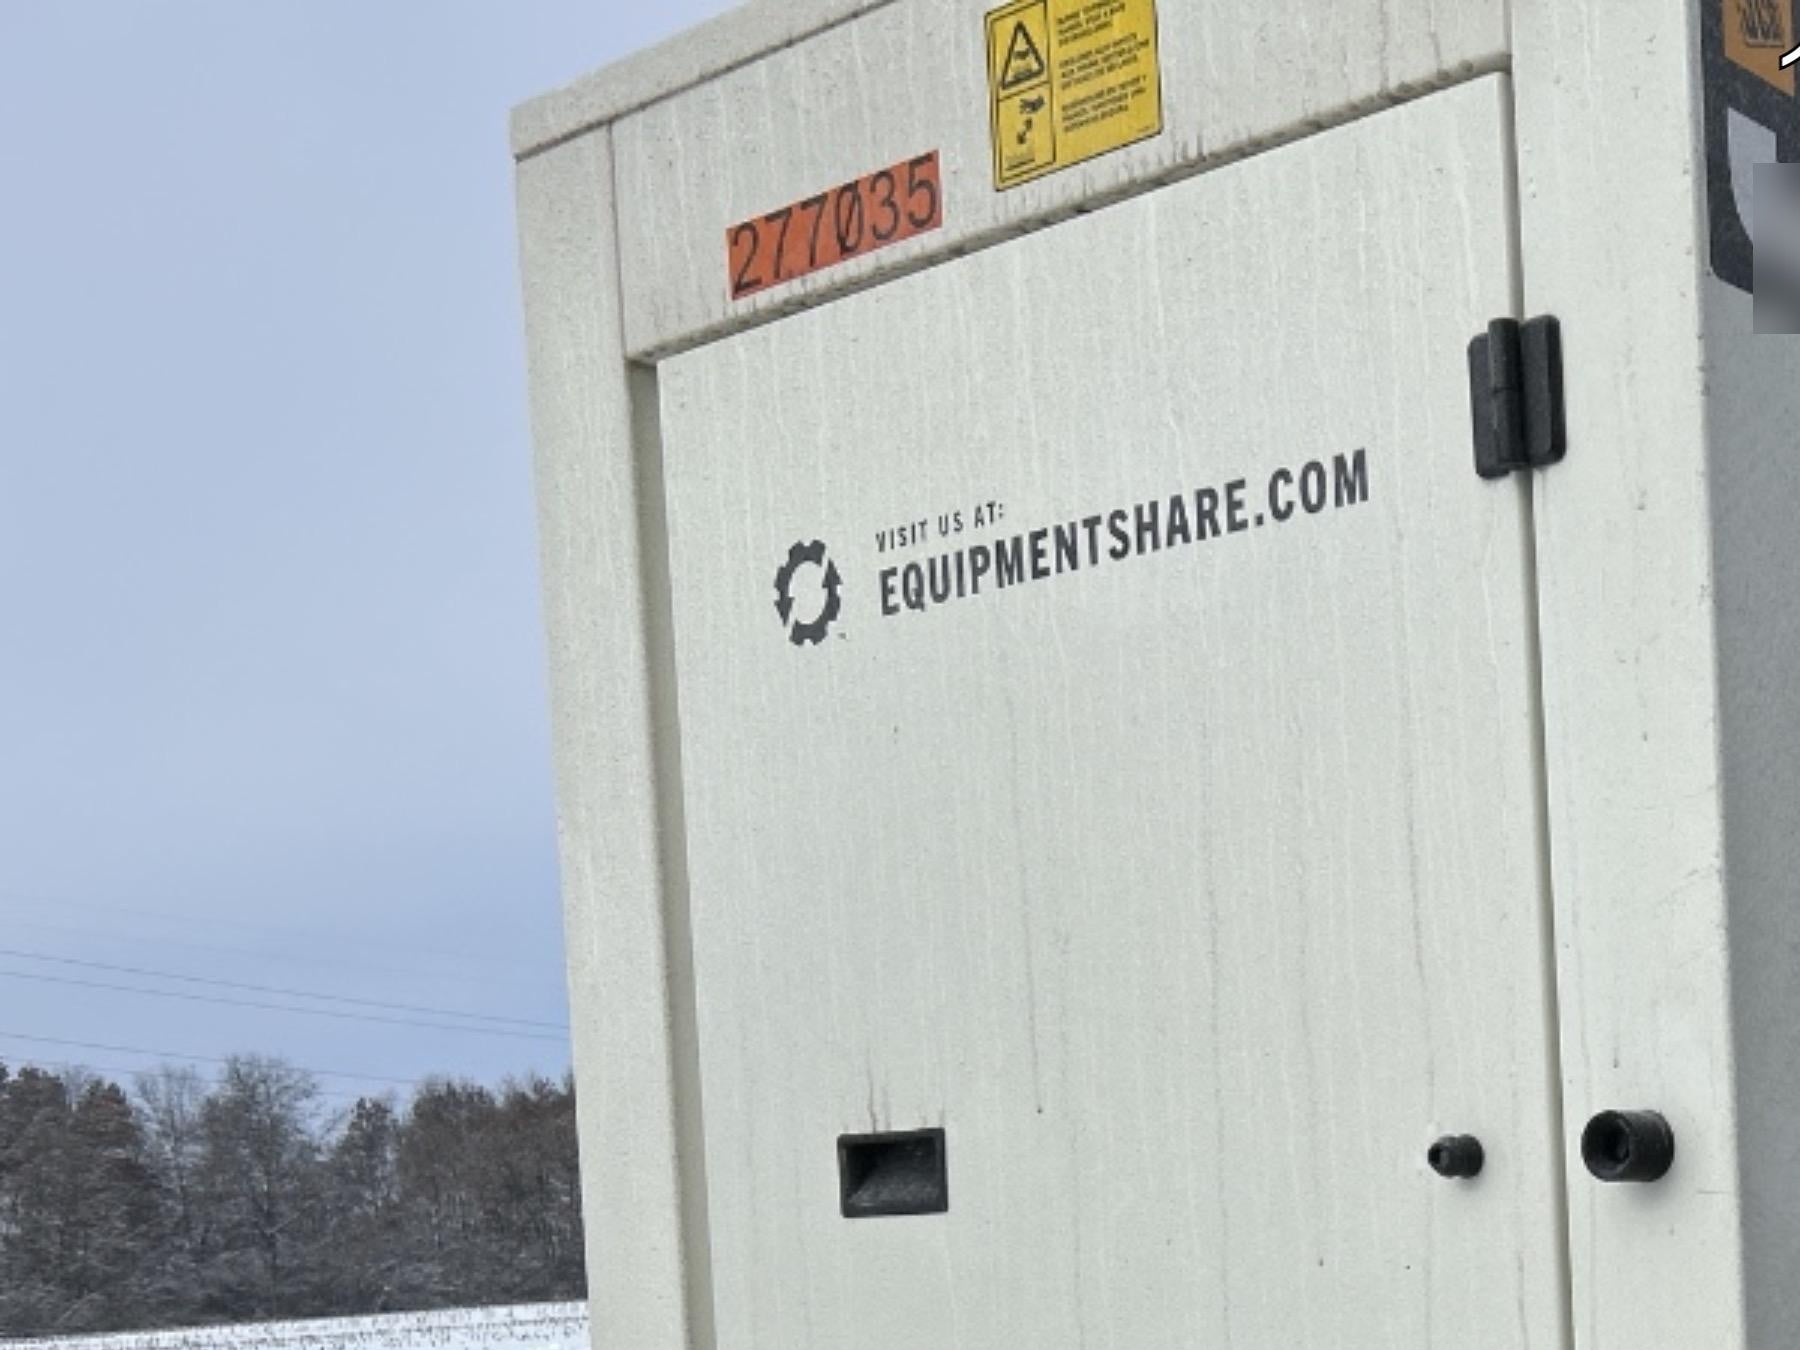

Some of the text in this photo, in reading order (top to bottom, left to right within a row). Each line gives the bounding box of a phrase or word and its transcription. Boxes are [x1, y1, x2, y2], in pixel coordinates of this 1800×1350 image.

[732, 152, 938, 293] 277035
[875, 501, 1005, 553] VISIT US AT:
[879, 447, 1369, 616] EQUIPMENTSHARE.COM
